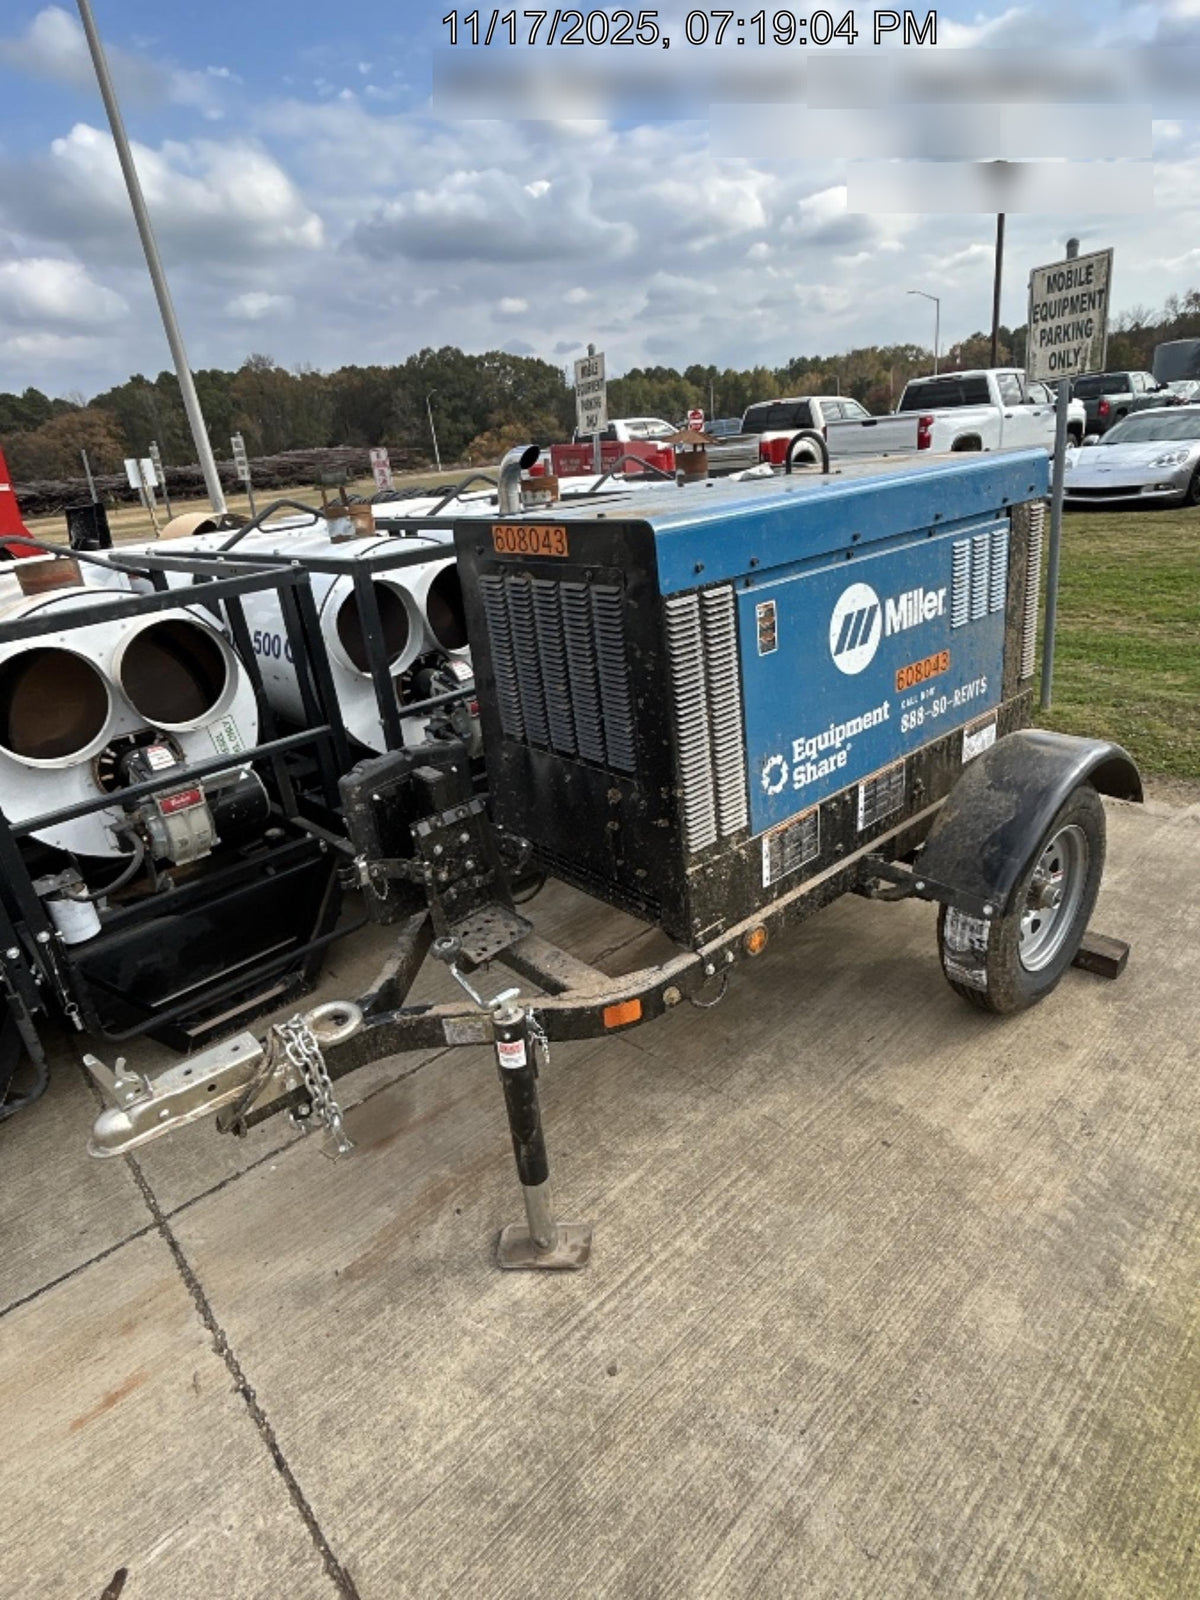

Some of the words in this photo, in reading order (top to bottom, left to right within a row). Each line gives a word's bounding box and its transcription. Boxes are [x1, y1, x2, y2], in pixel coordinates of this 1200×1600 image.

[1046, 263, 1094, 294] MOBILE
[1032, 288, 1105, 324] EQUIPMENT
[1040, 317, 1094, 348] PARKING
[1048, 346, 1082, 371] ONLY
[495, 527, 566, 555] 608043
[885, 587, 947, 637] Miller
[253, 630, 282, 660] 500
[897, 651, 949, 691] 608043
[901, 675, 987, 733] 888-80-RENTS
[792, 700, 890, 763] Equipment
